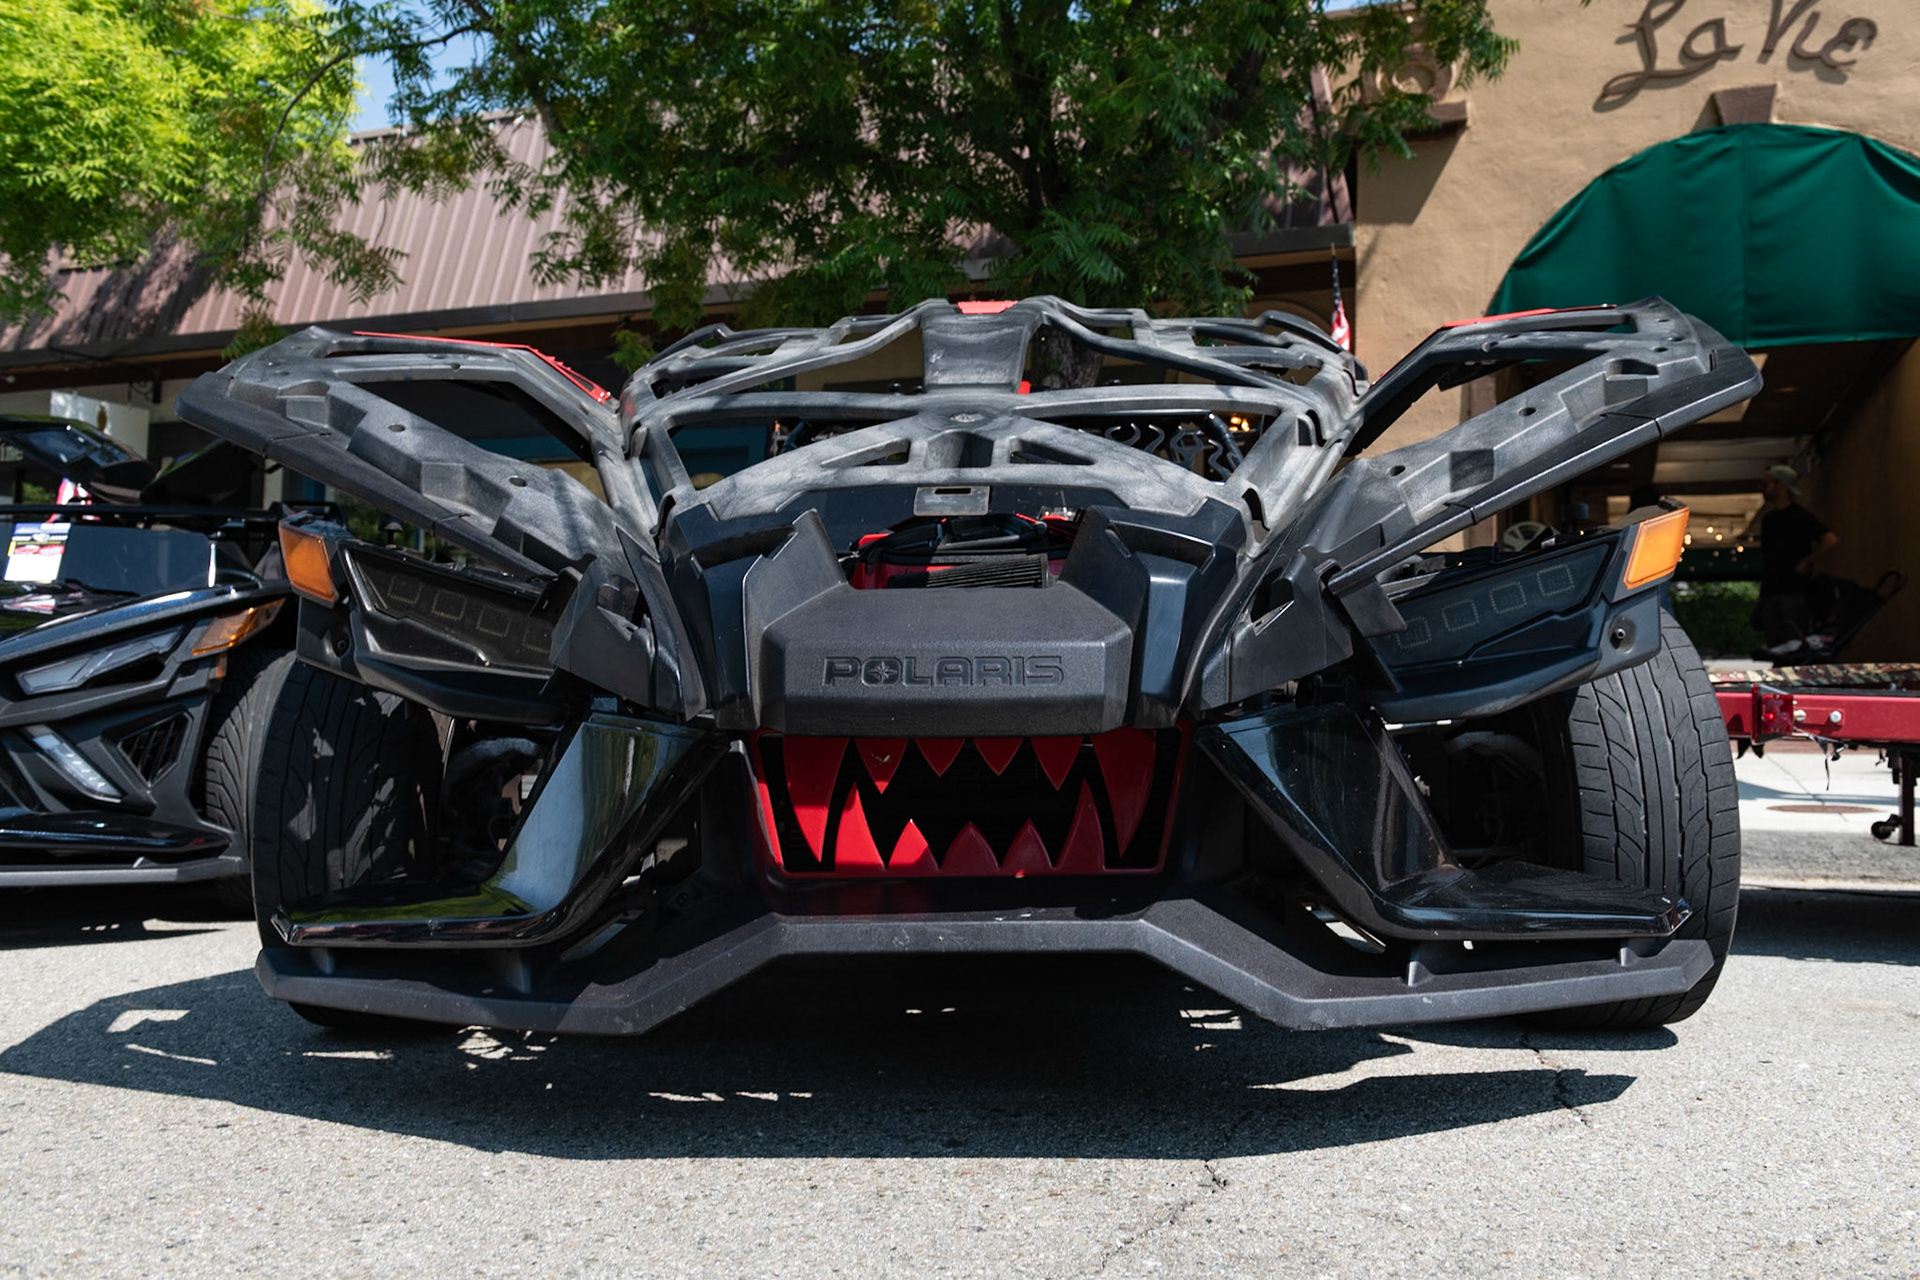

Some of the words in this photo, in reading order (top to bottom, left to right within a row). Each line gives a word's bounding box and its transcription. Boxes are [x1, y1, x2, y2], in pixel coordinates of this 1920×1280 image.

[1602, 0, 1744, 95] La
[1762, 0, 1877, 69] Vie
[823, 656, 1065, 686] POLARIS
